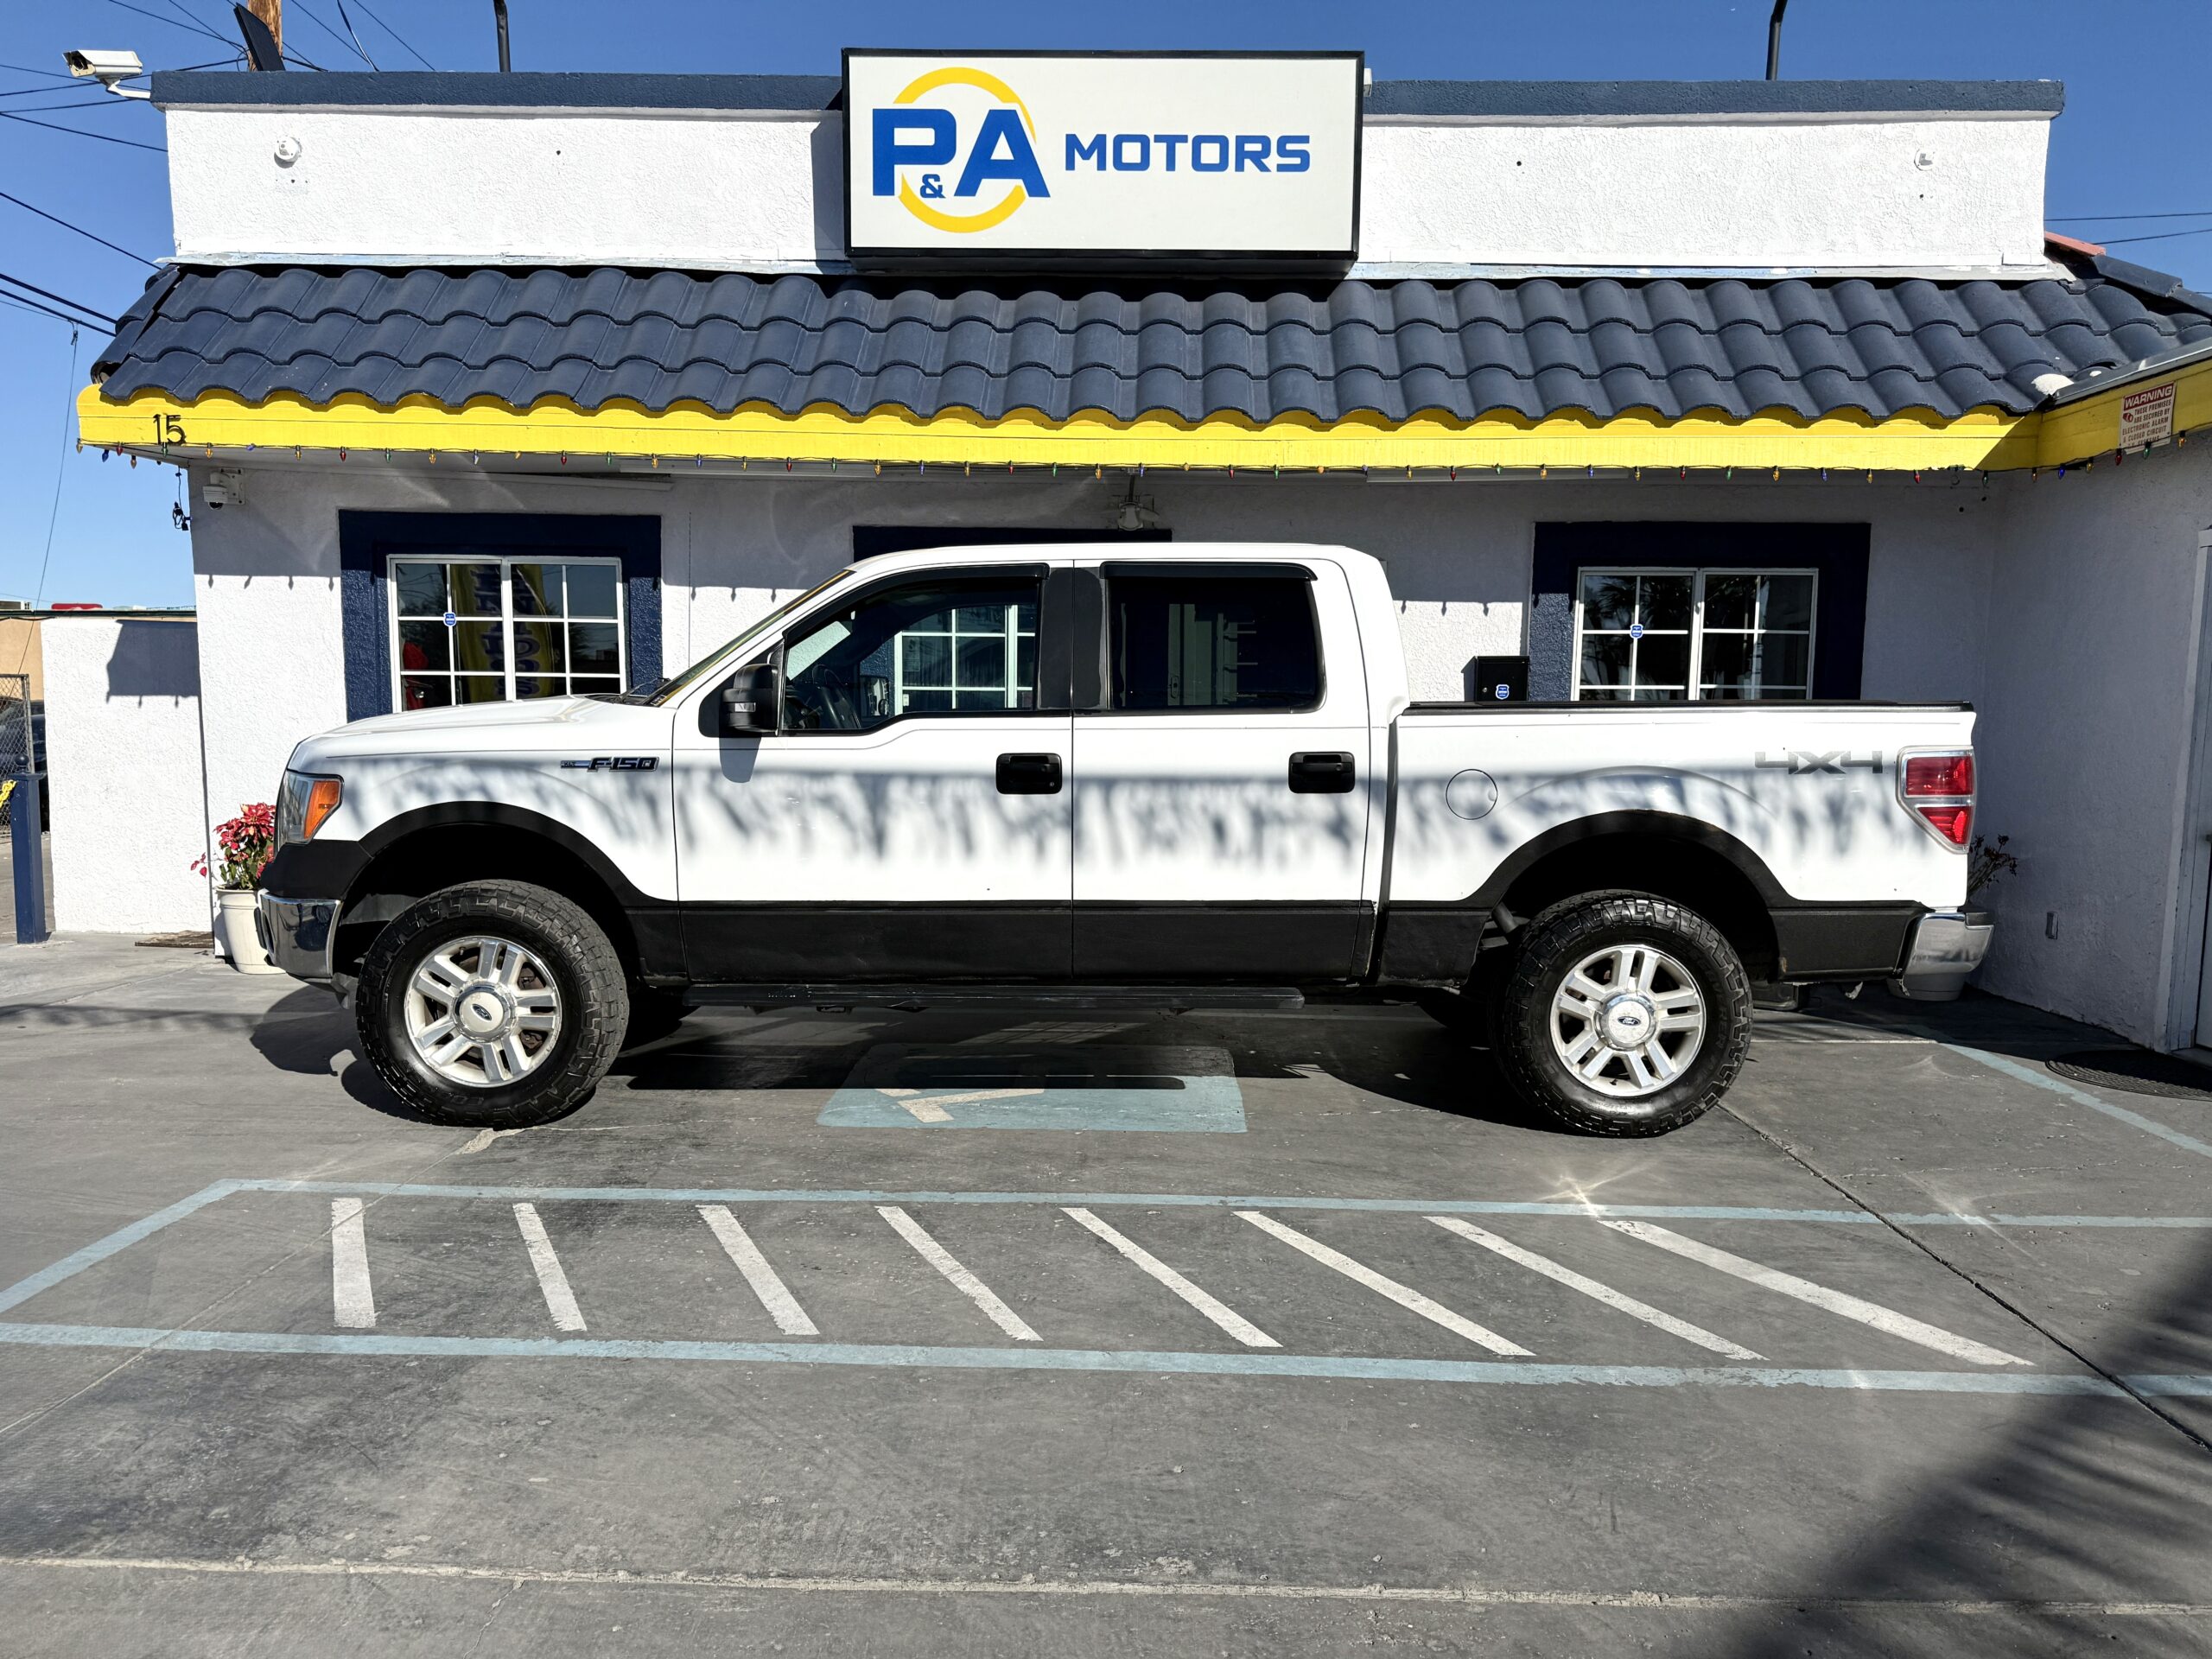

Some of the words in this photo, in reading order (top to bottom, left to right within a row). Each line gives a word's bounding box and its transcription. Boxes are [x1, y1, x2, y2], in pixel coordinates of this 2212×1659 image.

[1065, 133, 1311, 173] MOTORS
[2126, 385, 2172, 409] WARNING
[2135, 406, 2147, 415] THESE
[2149, 399, 2171, 411] PREMISES
[2134, 415, 2143, 423] ARE
[2143, 410, 2163, 421] SECURED
[153, 414, 186, 445] 15
[2122, 423, 2150, 435] ELECTRONIC
[2152, 417, 2168, 426] ALARM
[2128, 430, 2145, 441] CLOSED
[2147, 426, 2166, 435] CIRCUIT
